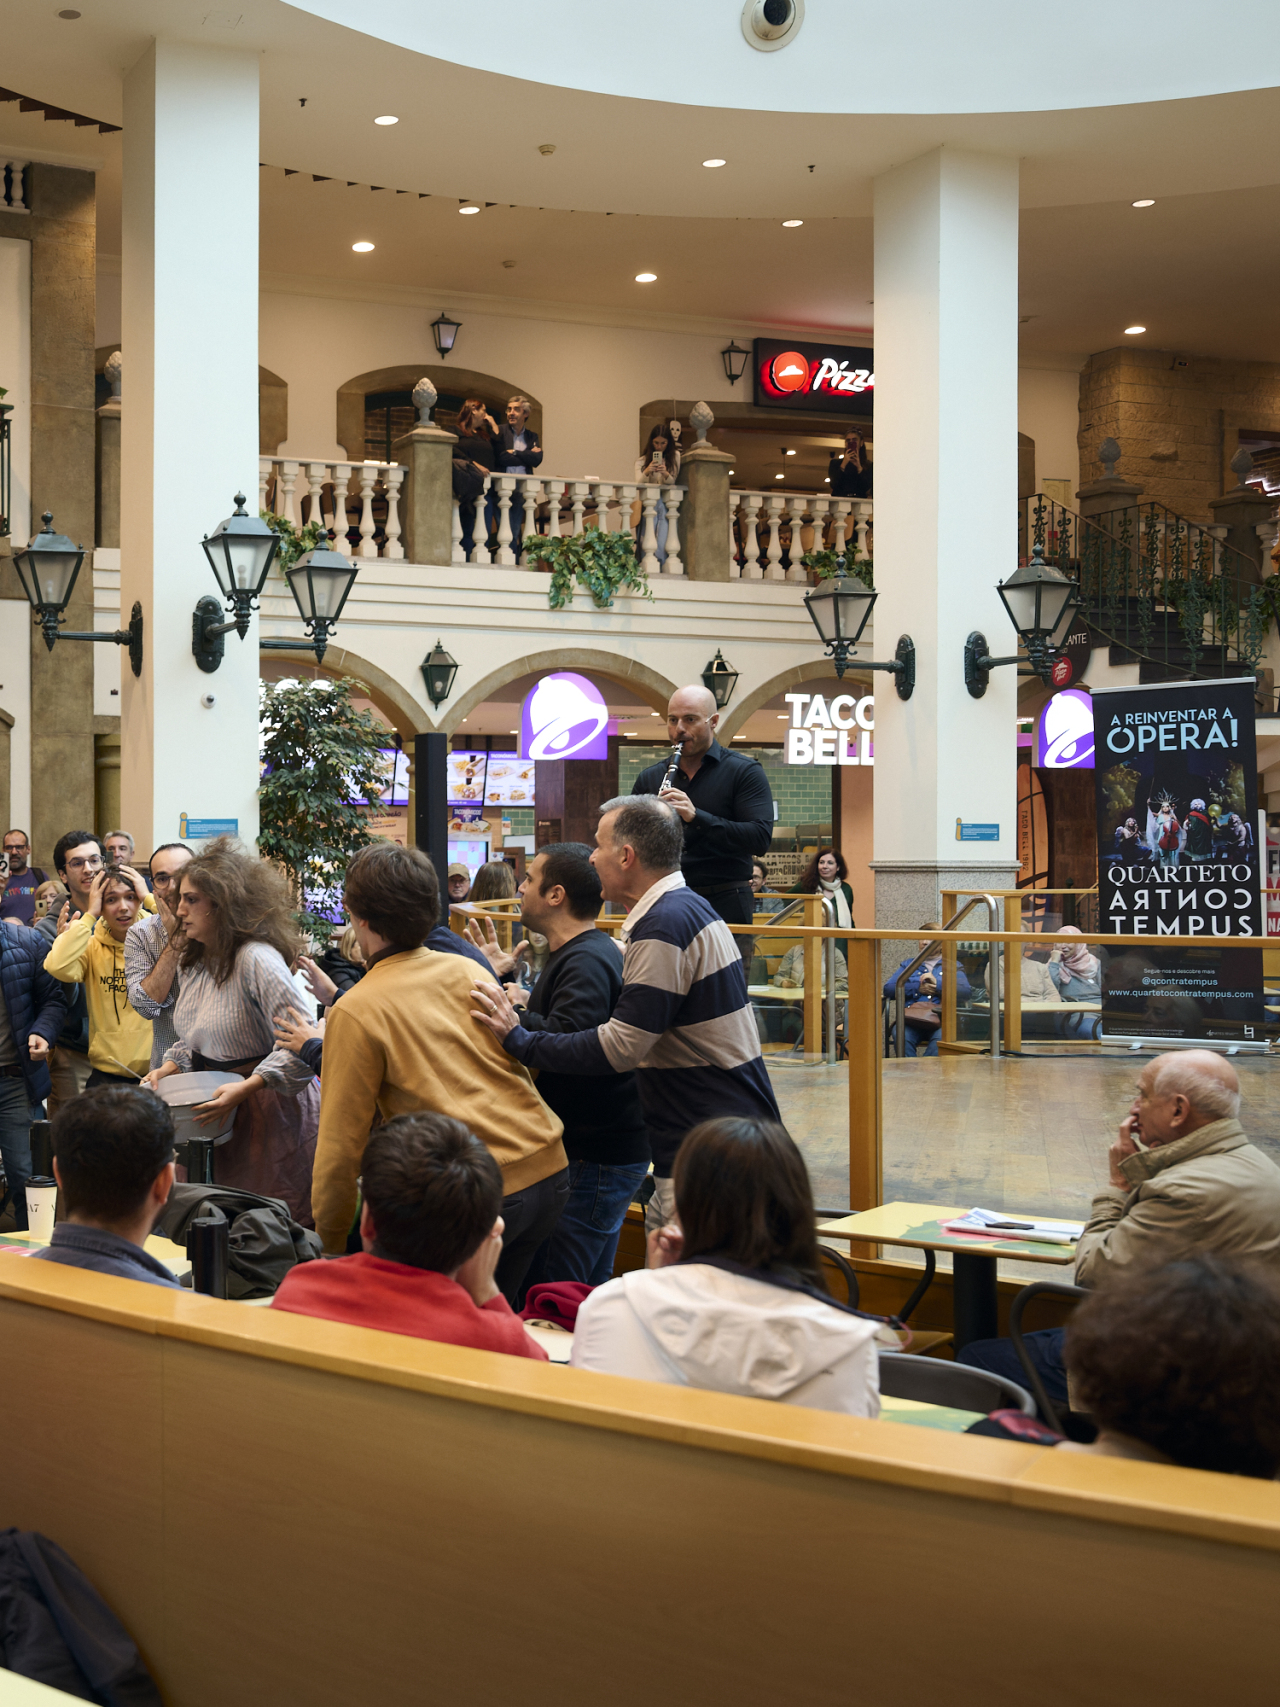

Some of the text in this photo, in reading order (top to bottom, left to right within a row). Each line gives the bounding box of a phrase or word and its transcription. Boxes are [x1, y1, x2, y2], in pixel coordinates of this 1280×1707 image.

[1066, 633, 1087, 645] ANTE
[784, 693, 875, 731] TACO
[1110, 706, 1234, 726] A REINVENTAR A
[787, 728, 875, 766] BELL
[1021, 810, 1029, 829] TACO
[1107, 864, 1253, 887] QUARTETO
[1108, 915, 1254, 937] TEMPUS
[99, 976, 127, 985] NORT
[1143, 967, 1171, 975] Segue-nos
[1141, 976, 1219, 987] @qcontratempus
[1108, 989, 1254, 999] www.quartetocontratempus.com
